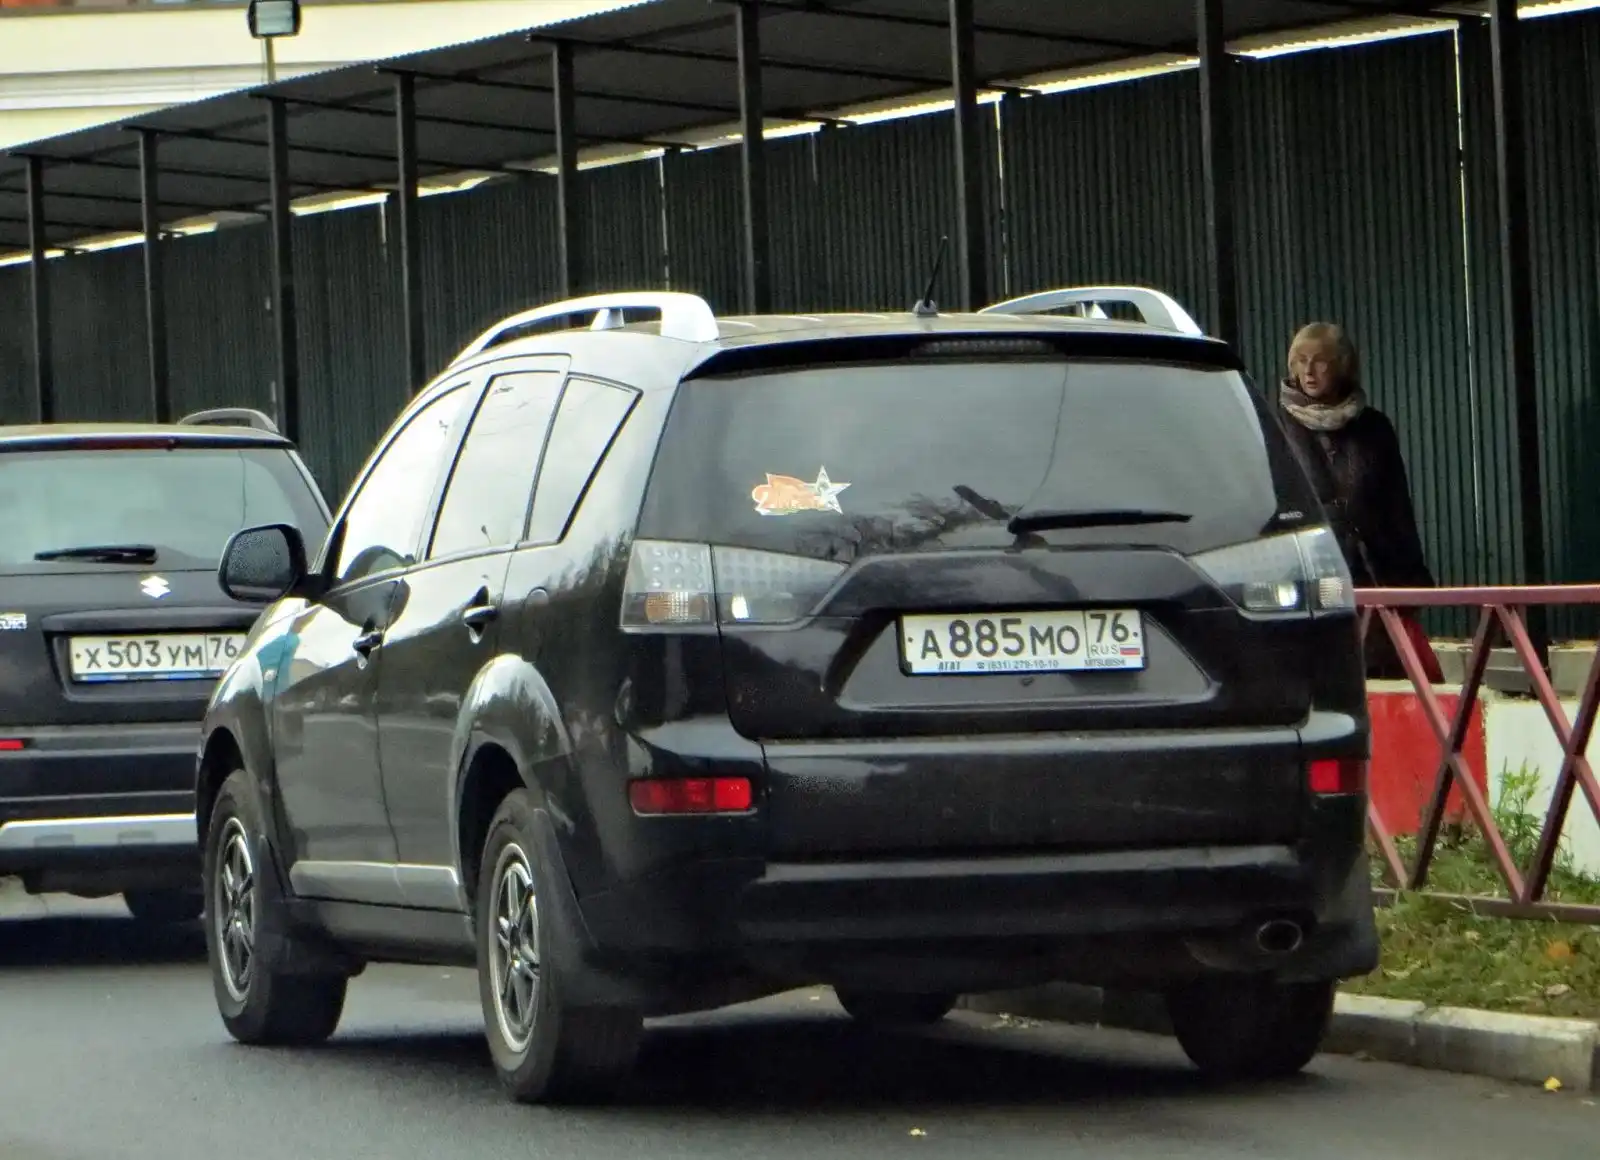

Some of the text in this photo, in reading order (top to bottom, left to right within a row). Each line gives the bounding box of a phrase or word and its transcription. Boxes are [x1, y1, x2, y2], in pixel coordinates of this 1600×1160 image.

[1089, 612, 1130, 643] 76
[209, 636, 238, 659] 76
[1090, 644, 1120, 656] RUS
